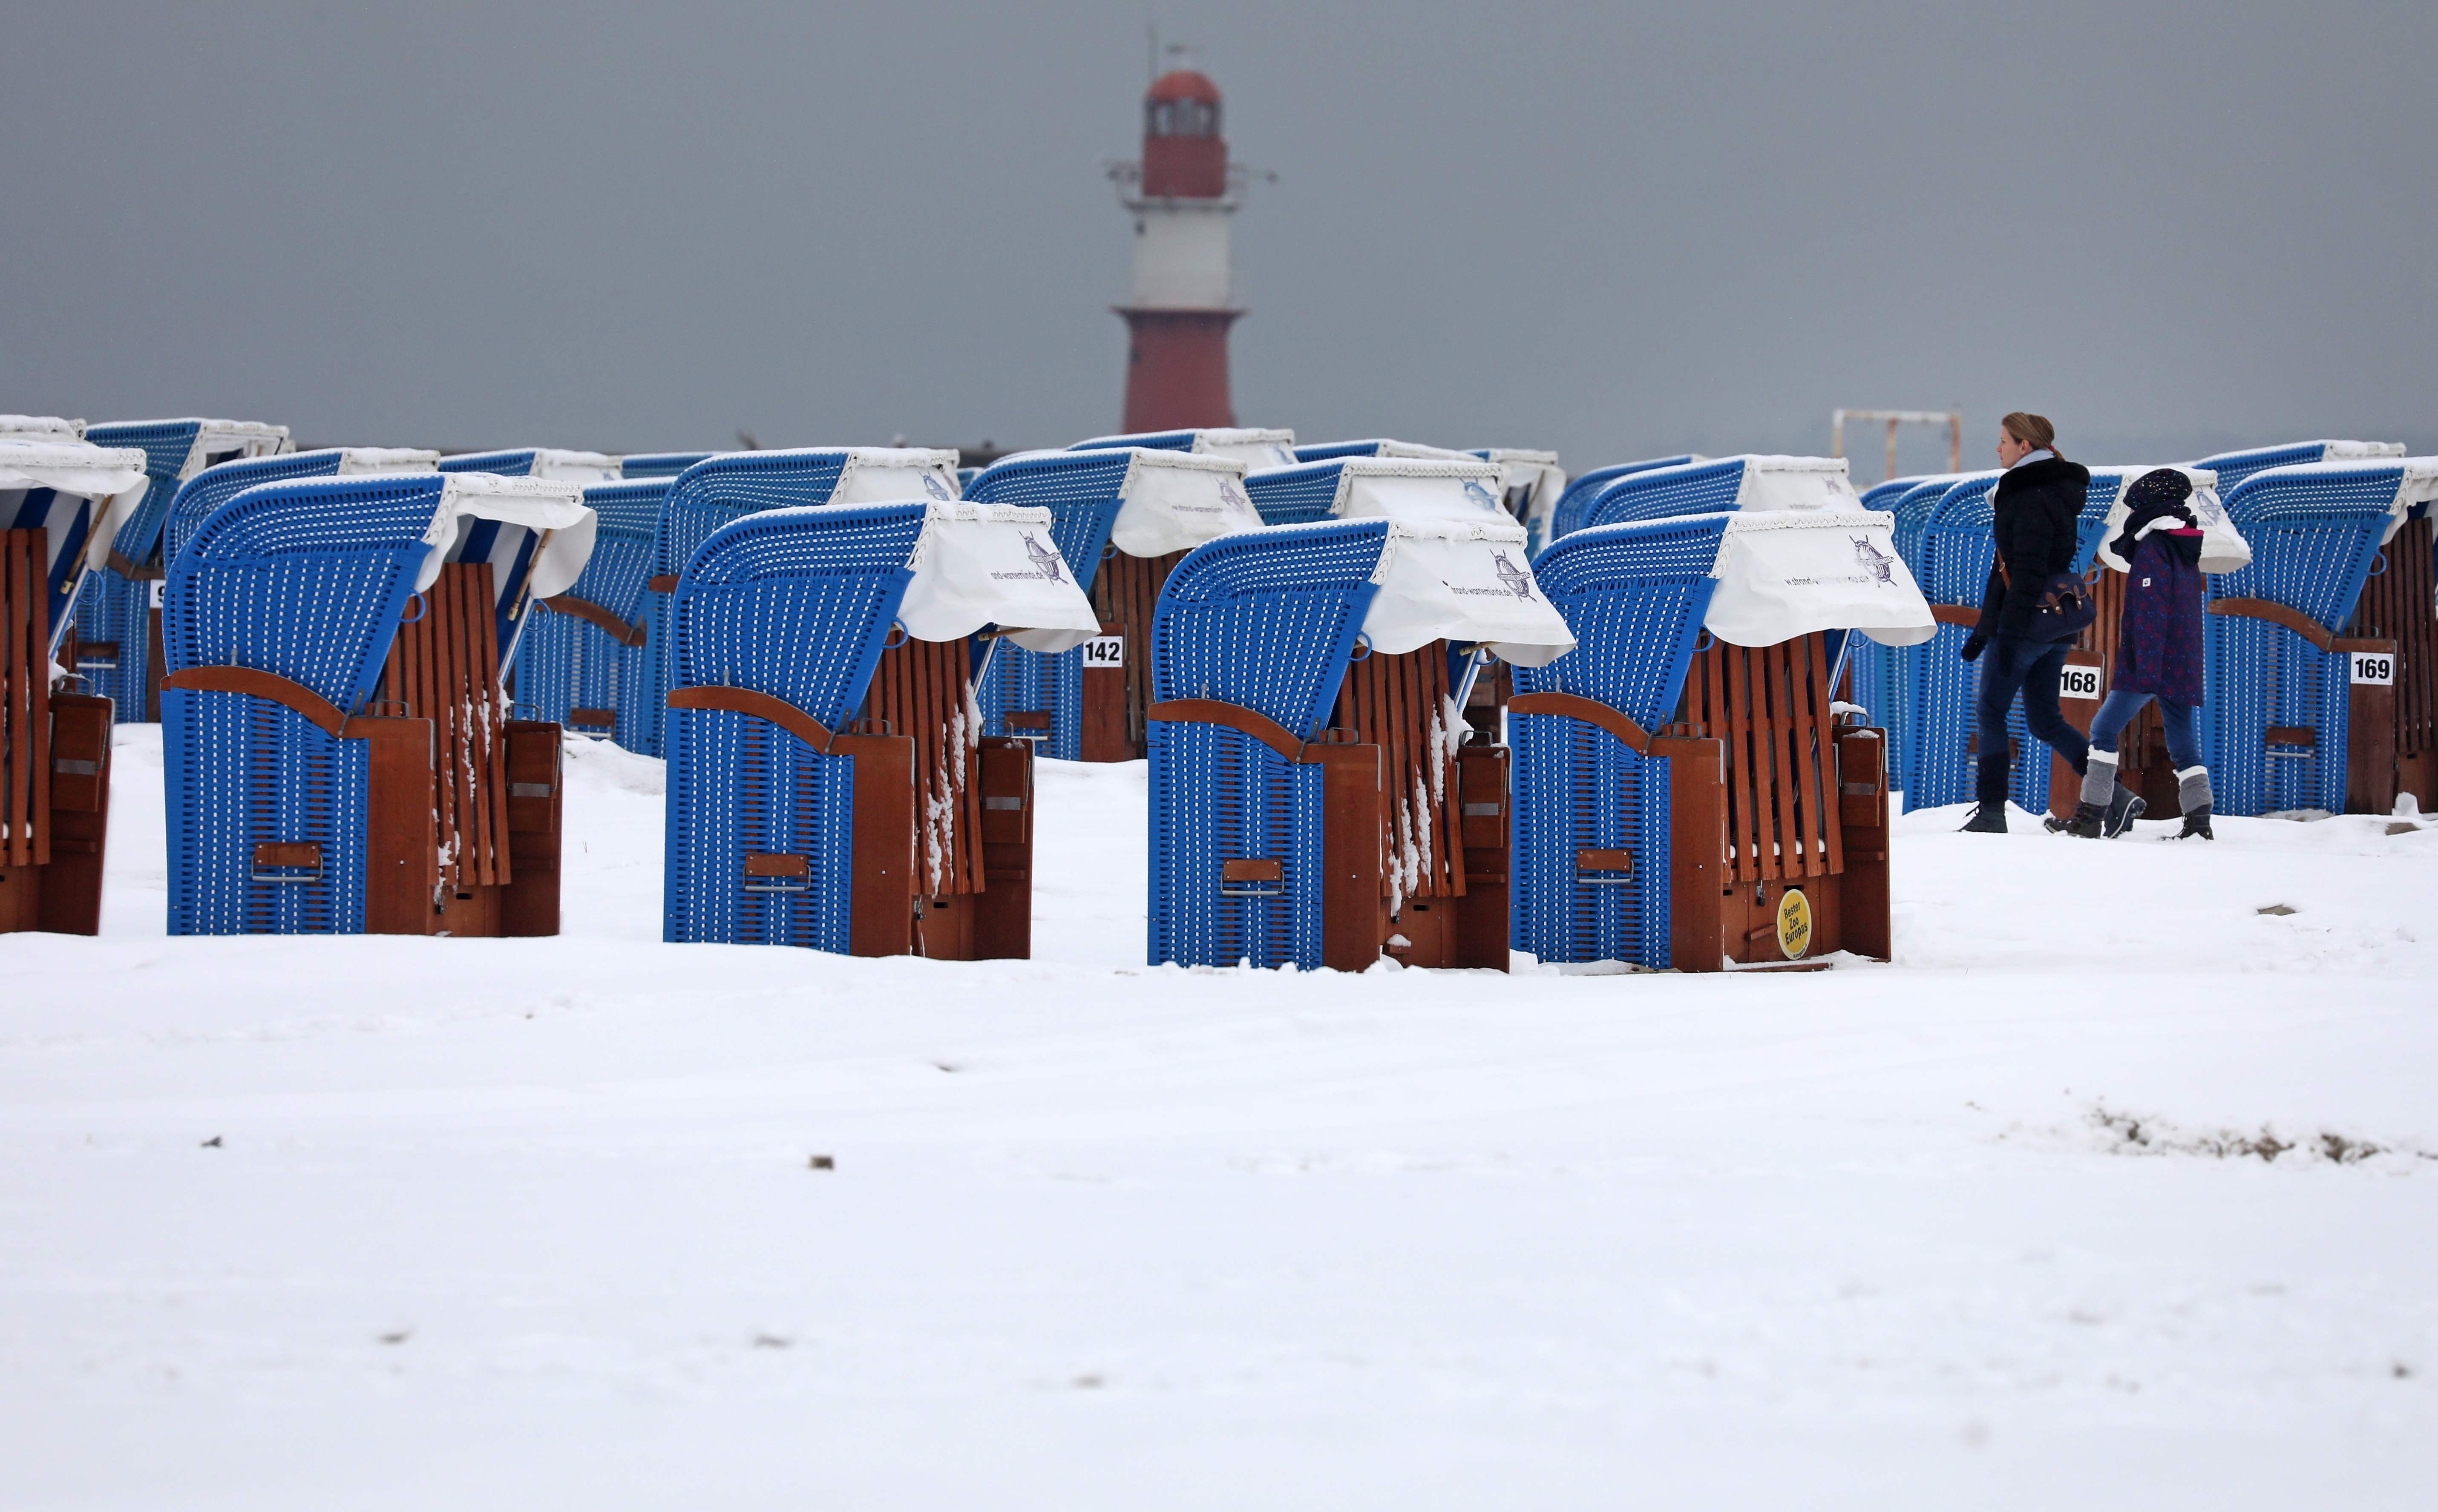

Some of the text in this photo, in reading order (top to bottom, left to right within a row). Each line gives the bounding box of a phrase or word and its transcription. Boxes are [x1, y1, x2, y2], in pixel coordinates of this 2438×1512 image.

[1085, 641, 1120, 661] 142
[2355, 658, 2389, 679] 169
[2061, 671, 2096, 693] 168
[1784, 902, 1801, 920] Bester
[1785, 922, 1808, 945] Europas
[1789, 917, 1799, 930] Zoo
